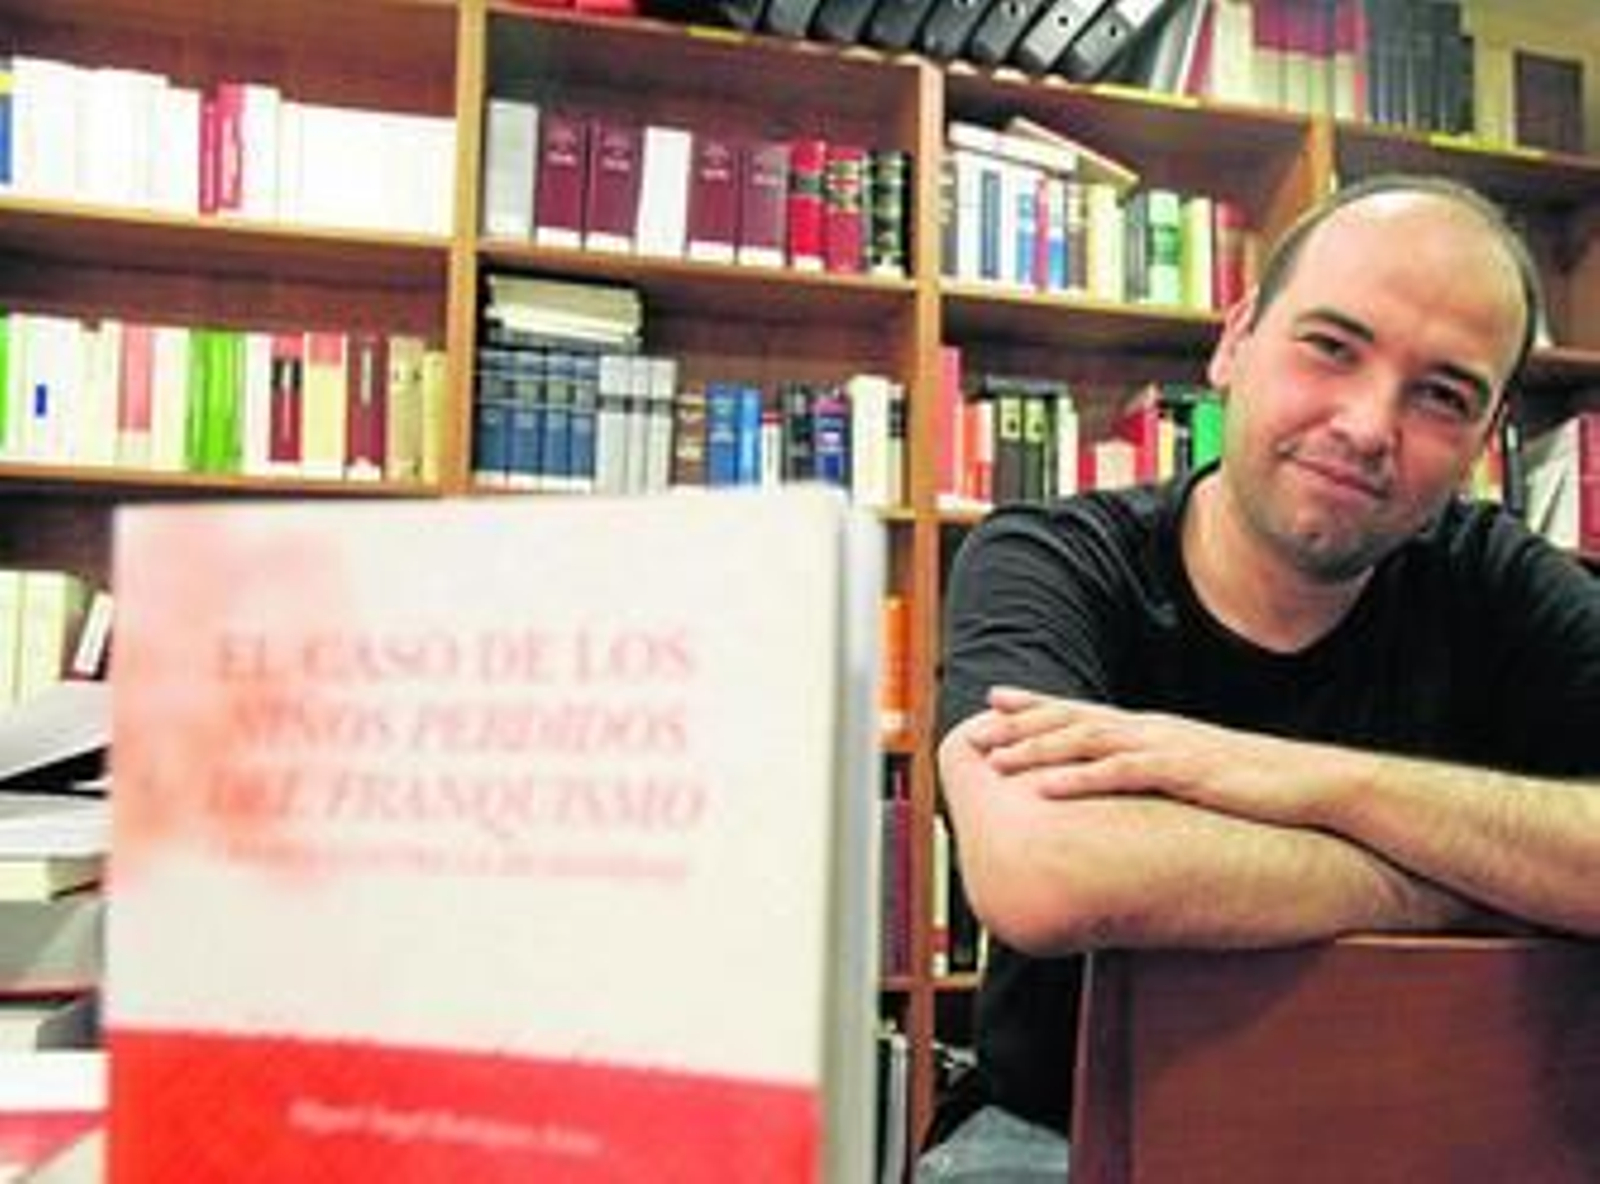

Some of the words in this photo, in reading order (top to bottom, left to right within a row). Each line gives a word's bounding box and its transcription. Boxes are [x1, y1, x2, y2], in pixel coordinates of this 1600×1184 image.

[214, 630, 281, 684] EL
[300, 628, 459, 685] CASO
[478, 627, 555, 685] DE
[573, 625, 695, 685] LOS
[326, 768, 708, 840] FRANQUISMO
